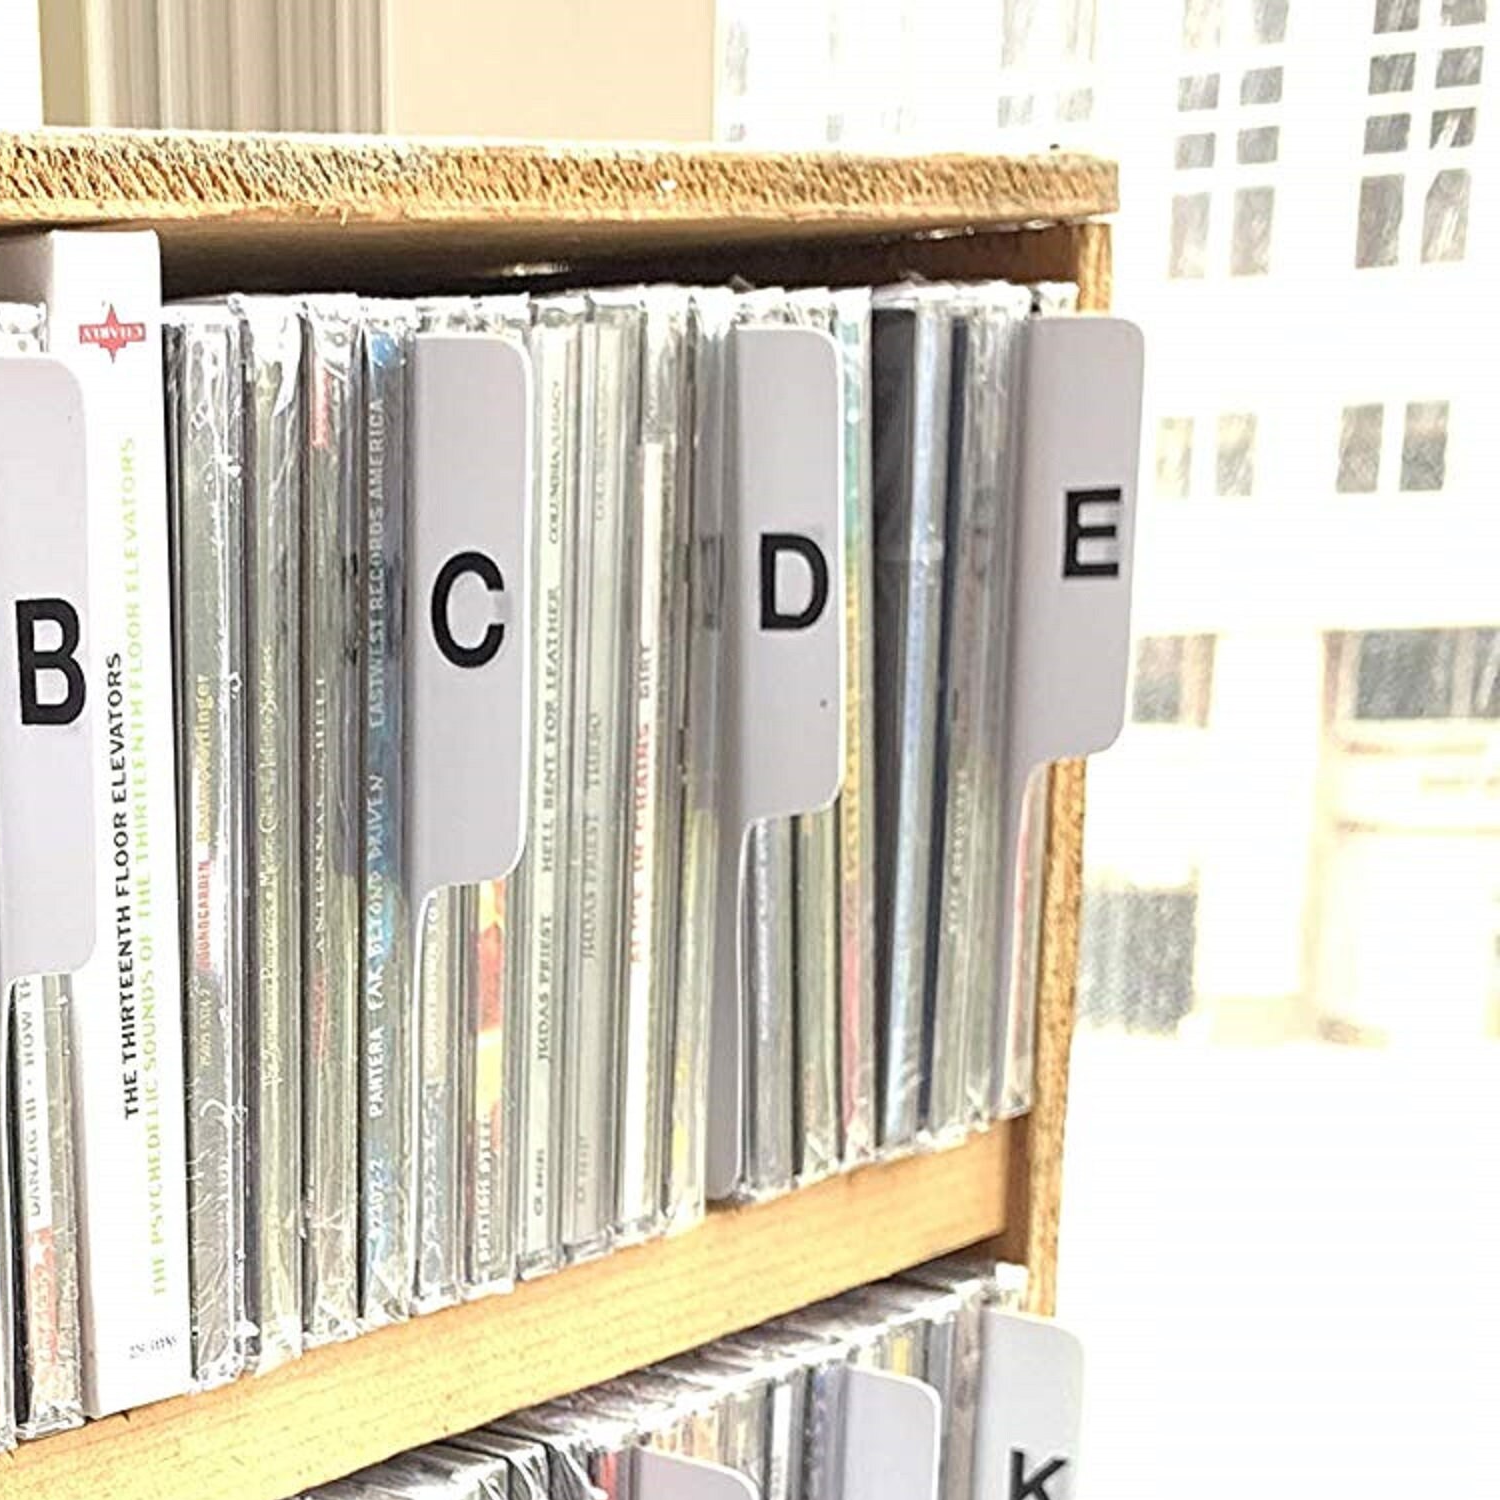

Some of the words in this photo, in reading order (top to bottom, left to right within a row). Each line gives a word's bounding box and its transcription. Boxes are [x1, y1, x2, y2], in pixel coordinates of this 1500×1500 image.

[369, 398, 385, 500] AMERICA
[118, 436, 140, 593] ELEVATORS
[368, 507, 385, 610] RECORDS
[1063, 487, 1121, 578] E
[429, 551, 506, 669] C
[760, 533, 828, 629] D
[15, 597, 87, 725] B
[125, 602, 143, 687] FLOOR
[369, 617, 385, 727] EASTWEST
[546, 585, 559, 693] LEATHER
[105, 653, 127, 804] ELEVATORS
[543, 693, 556, 743] FOR
[129, 690, 151, 867] THIRTEENTH
[368, 774, 384, 860] DRIVEN
[544, 757, 554, 810] BENT
[112, 811, 130, 898] FLOOR
[542, 819, 553, 872] HELL
[136, 877, 151, 919] THE
[367, 871, 384, 958] BEYOND
[116, 904, 137, 1065] THIRTEENTH
[139, 934, 153, 963] OF
[367, 963, 385, 1012] FAR
[539, 914, 551, 984] PRIEST
[139, 969, 159, 1074] SOUNDS
[537, 993, 551, 1062] JUDAS
[124, 1069, 139, 1120] THE
[368, 1027, 385, 1116] PANTERA
